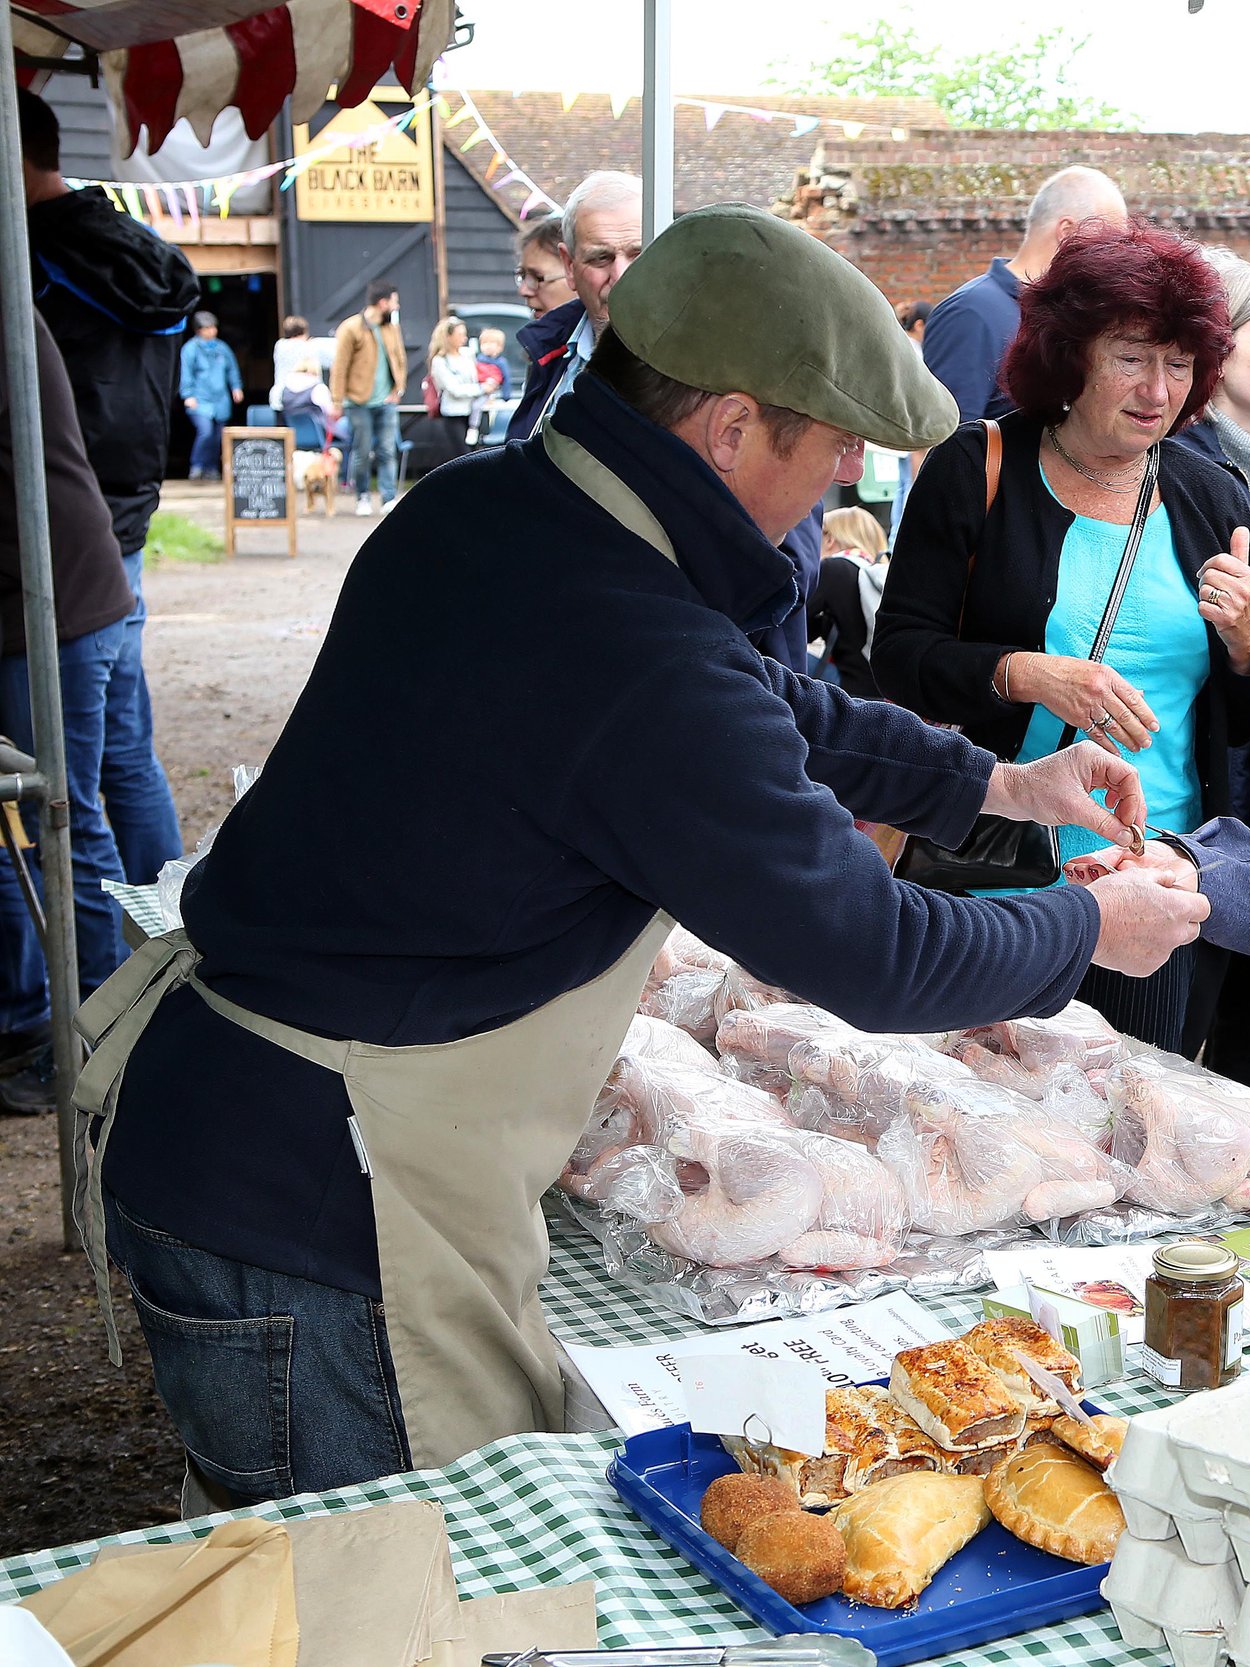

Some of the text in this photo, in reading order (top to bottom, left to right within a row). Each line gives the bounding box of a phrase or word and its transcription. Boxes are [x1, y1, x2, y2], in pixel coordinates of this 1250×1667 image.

[308, 168, 420, 191] BLACK BARN
[817, 1328, 847, 1346] Card
[840, 1318, 885, 1352] collecting
[841, 1345, 880, 1372] Loyalty
[627, 1382, 656, 1406] Farm
[651, 1390, 686, 1419] ULTRY
